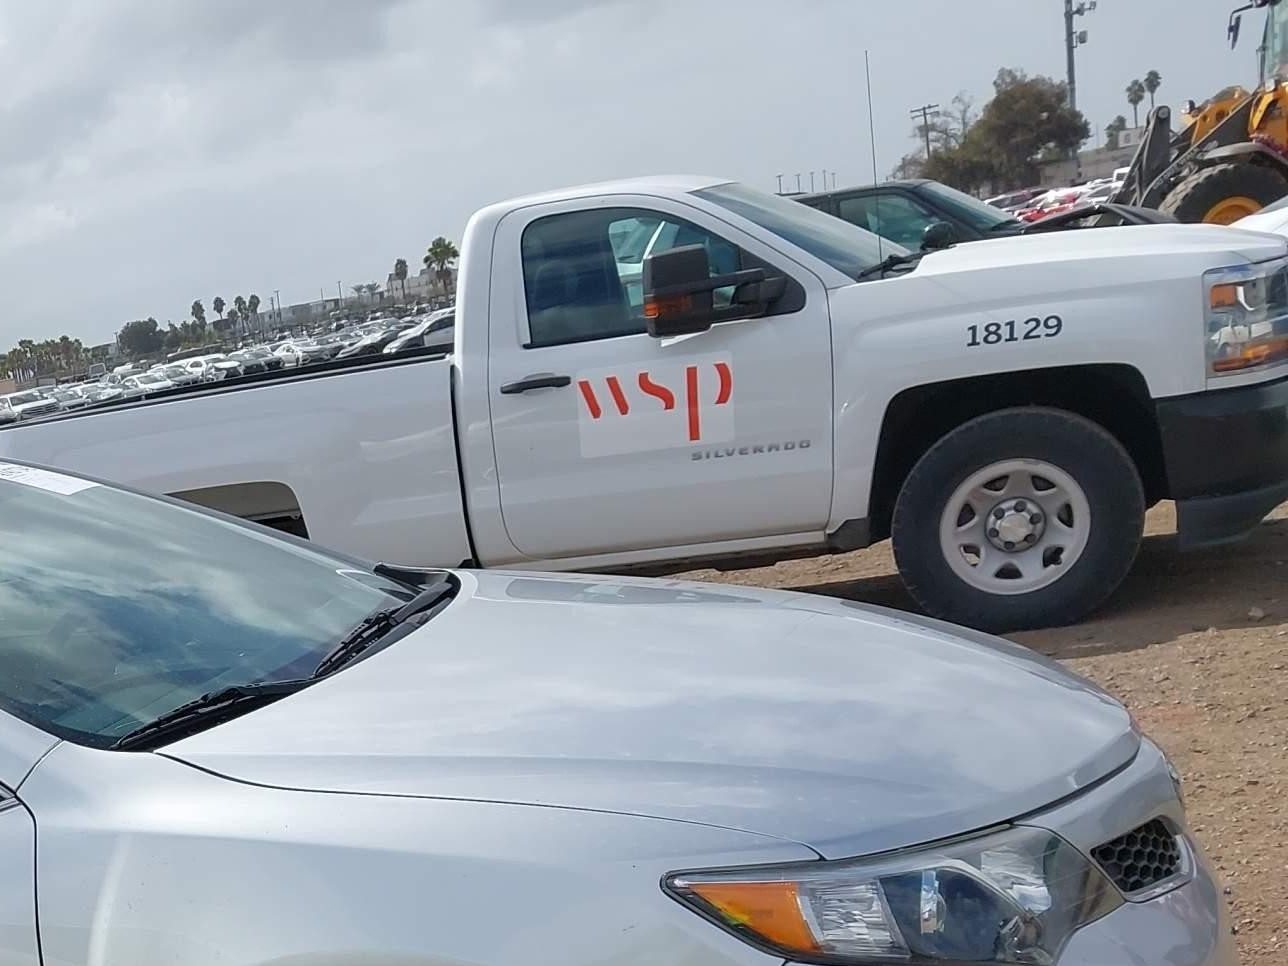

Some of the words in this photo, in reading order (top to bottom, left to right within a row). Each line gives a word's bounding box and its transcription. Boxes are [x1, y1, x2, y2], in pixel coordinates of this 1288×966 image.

[967, 315, 1062, 347] 18129
[577, 362, 733, 442] wsp
[691, 439, 812, 461] SILVERADO
